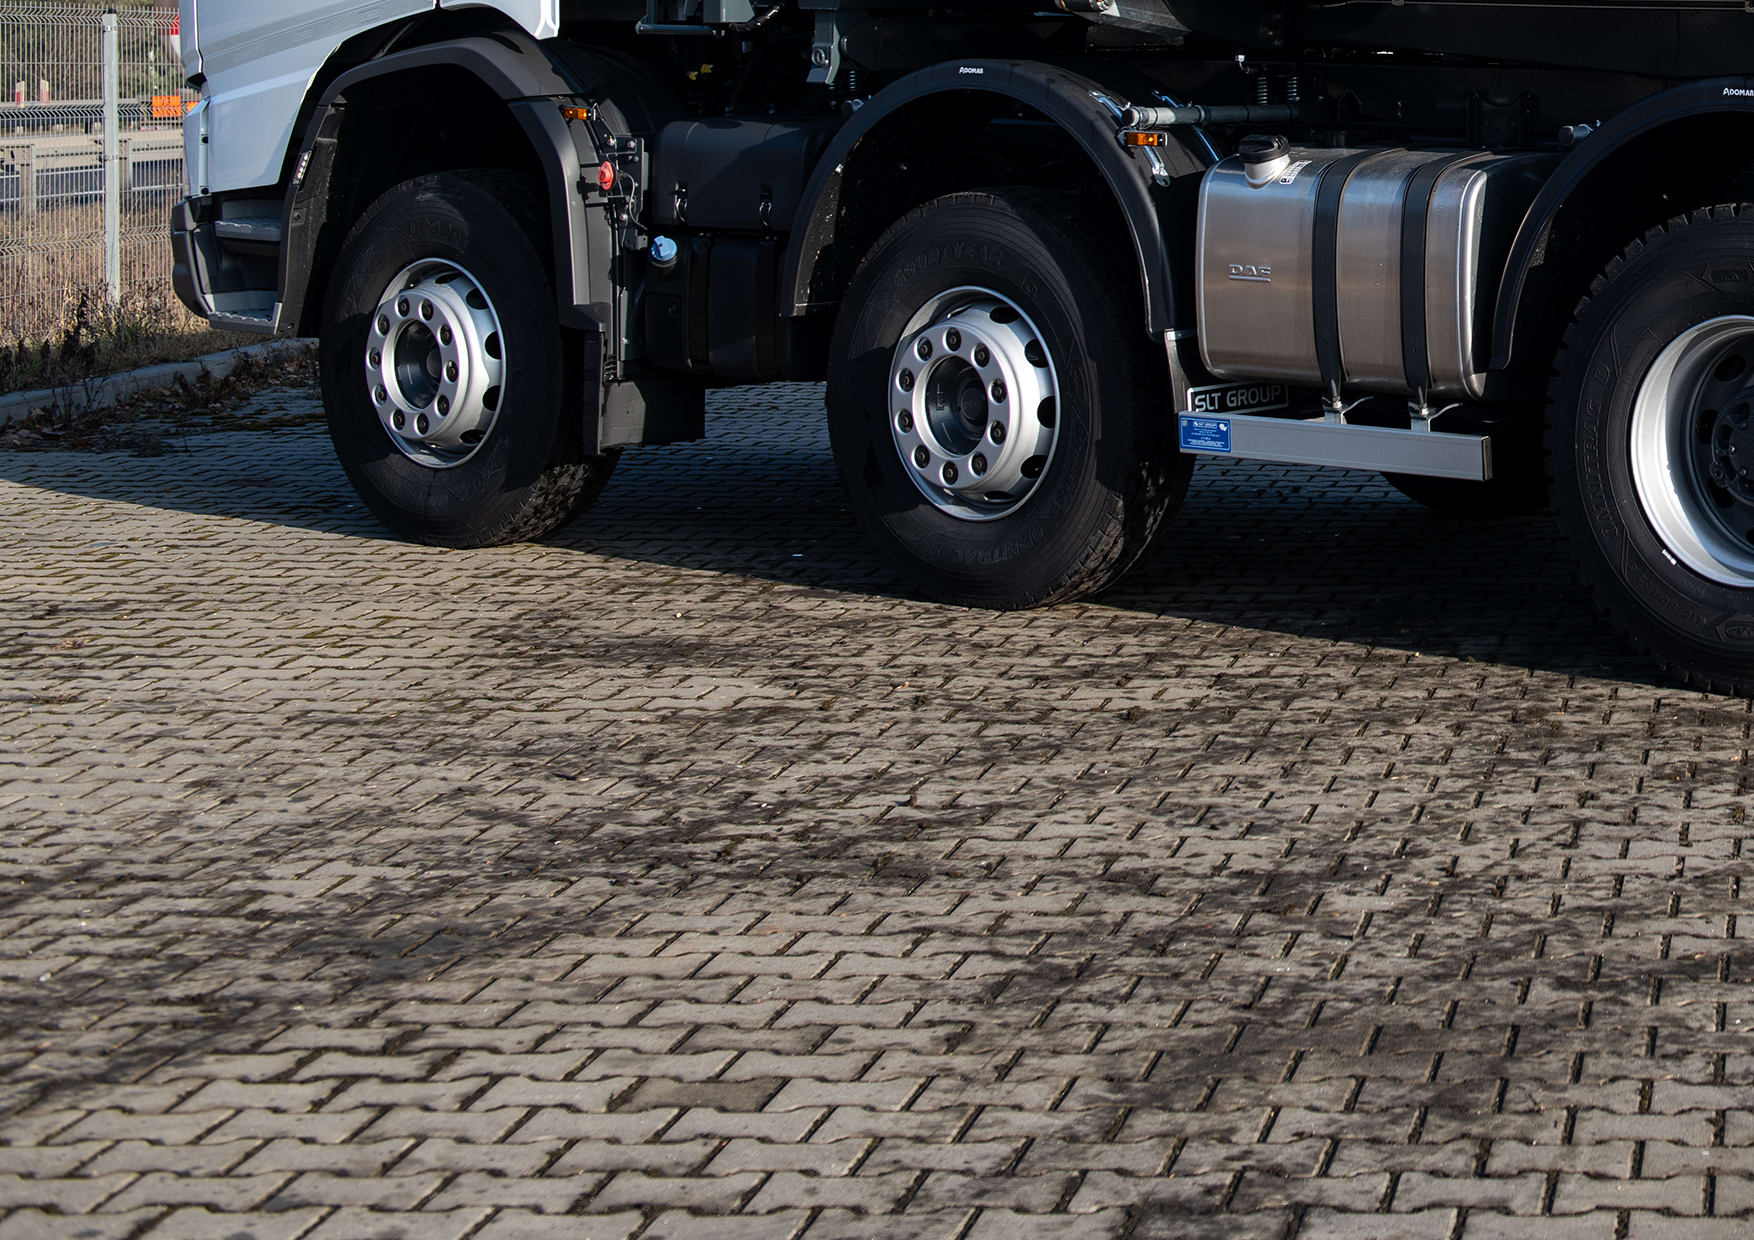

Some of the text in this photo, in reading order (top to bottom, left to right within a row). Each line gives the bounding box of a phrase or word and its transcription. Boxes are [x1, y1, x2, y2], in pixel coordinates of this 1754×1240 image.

[1723, 87, 1754, 97] ADOMAR
[1228, 264, 1272, 278] DAF
[1195, 385, 1282, 413] SLT GROUP
